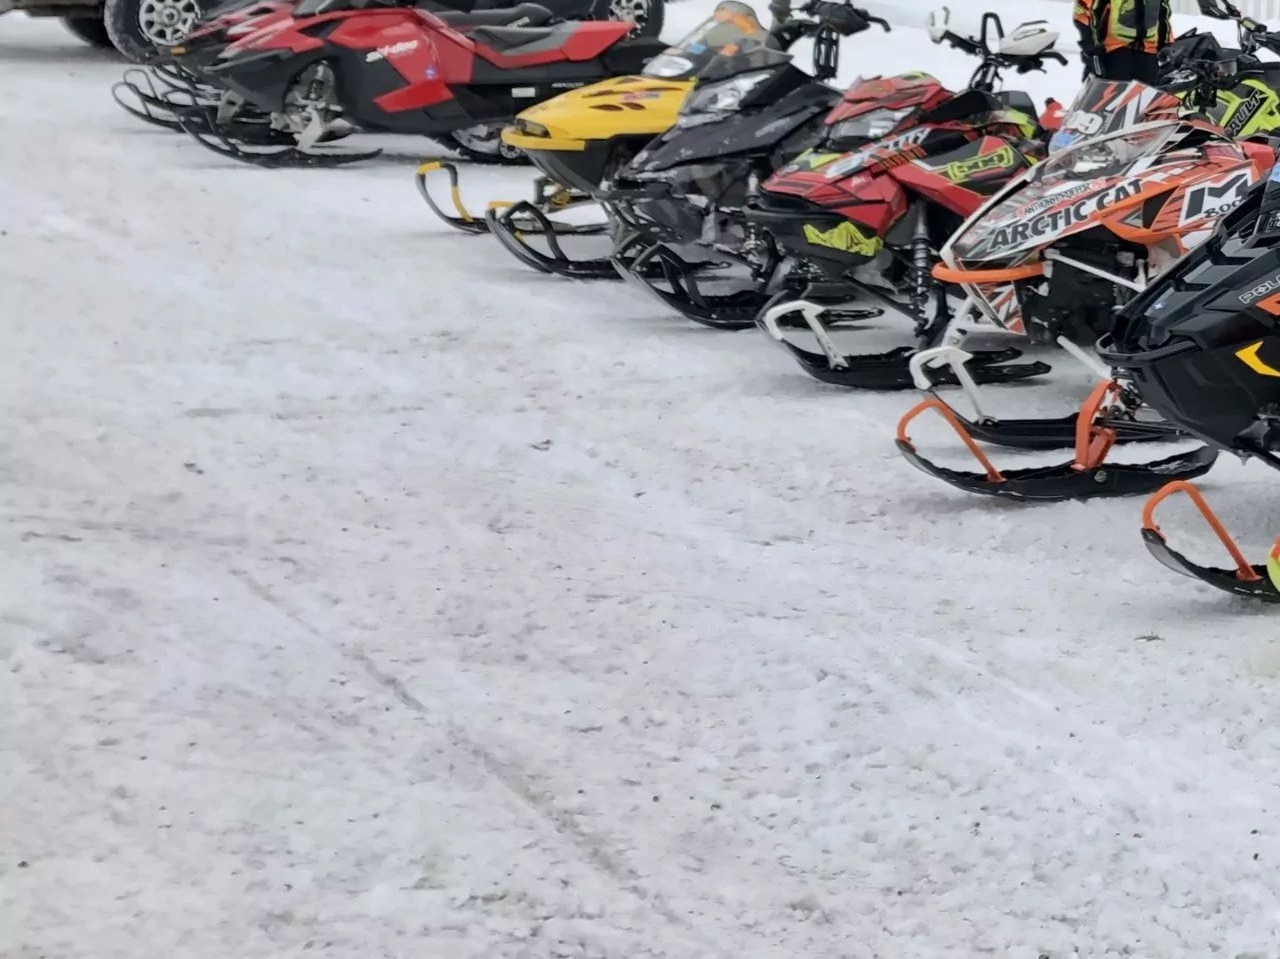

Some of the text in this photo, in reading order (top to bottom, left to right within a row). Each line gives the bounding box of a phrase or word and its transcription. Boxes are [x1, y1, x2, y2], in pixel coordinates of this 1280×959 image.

[1227, 88, 1262, 137] AULT
[988, 178, 1144, 251] ARCTIC CAT
